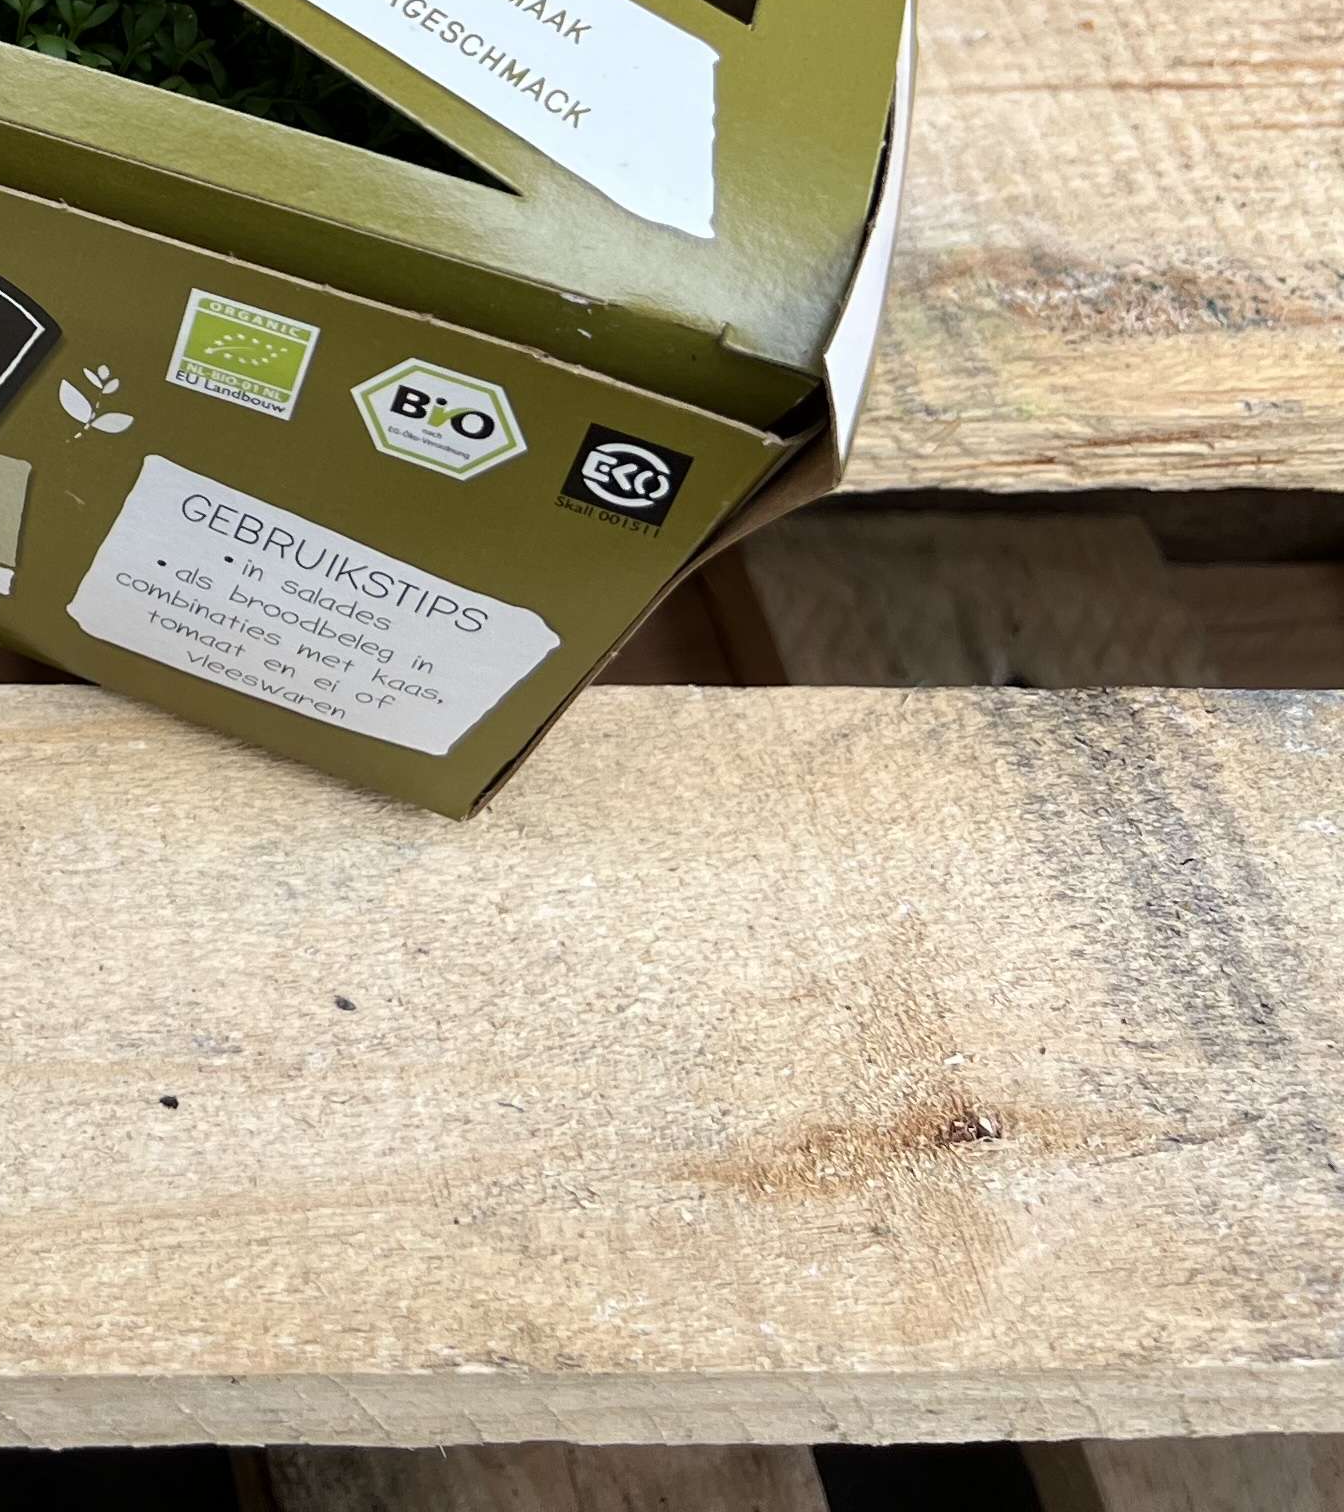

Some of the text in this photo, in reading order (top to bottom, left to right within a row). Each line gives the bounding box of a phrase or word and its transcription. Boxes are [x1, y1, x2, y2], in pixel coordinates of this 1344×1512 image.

[209, 301, 300, 338] ORGANIC
[175, 369, 286, 413] EU Landbouw
[180, 494, 490, 634] GEBRUIKSTIPS
[242, 559, 392, 632] in salades
[115, 571, 445, 705] combinaties met kaas,
[147, 609, 398, 711] tomaat en ei of
[175, 564, 435, 675] als broodbeleg in
[185, 650, 347, 721] vleeswaren
